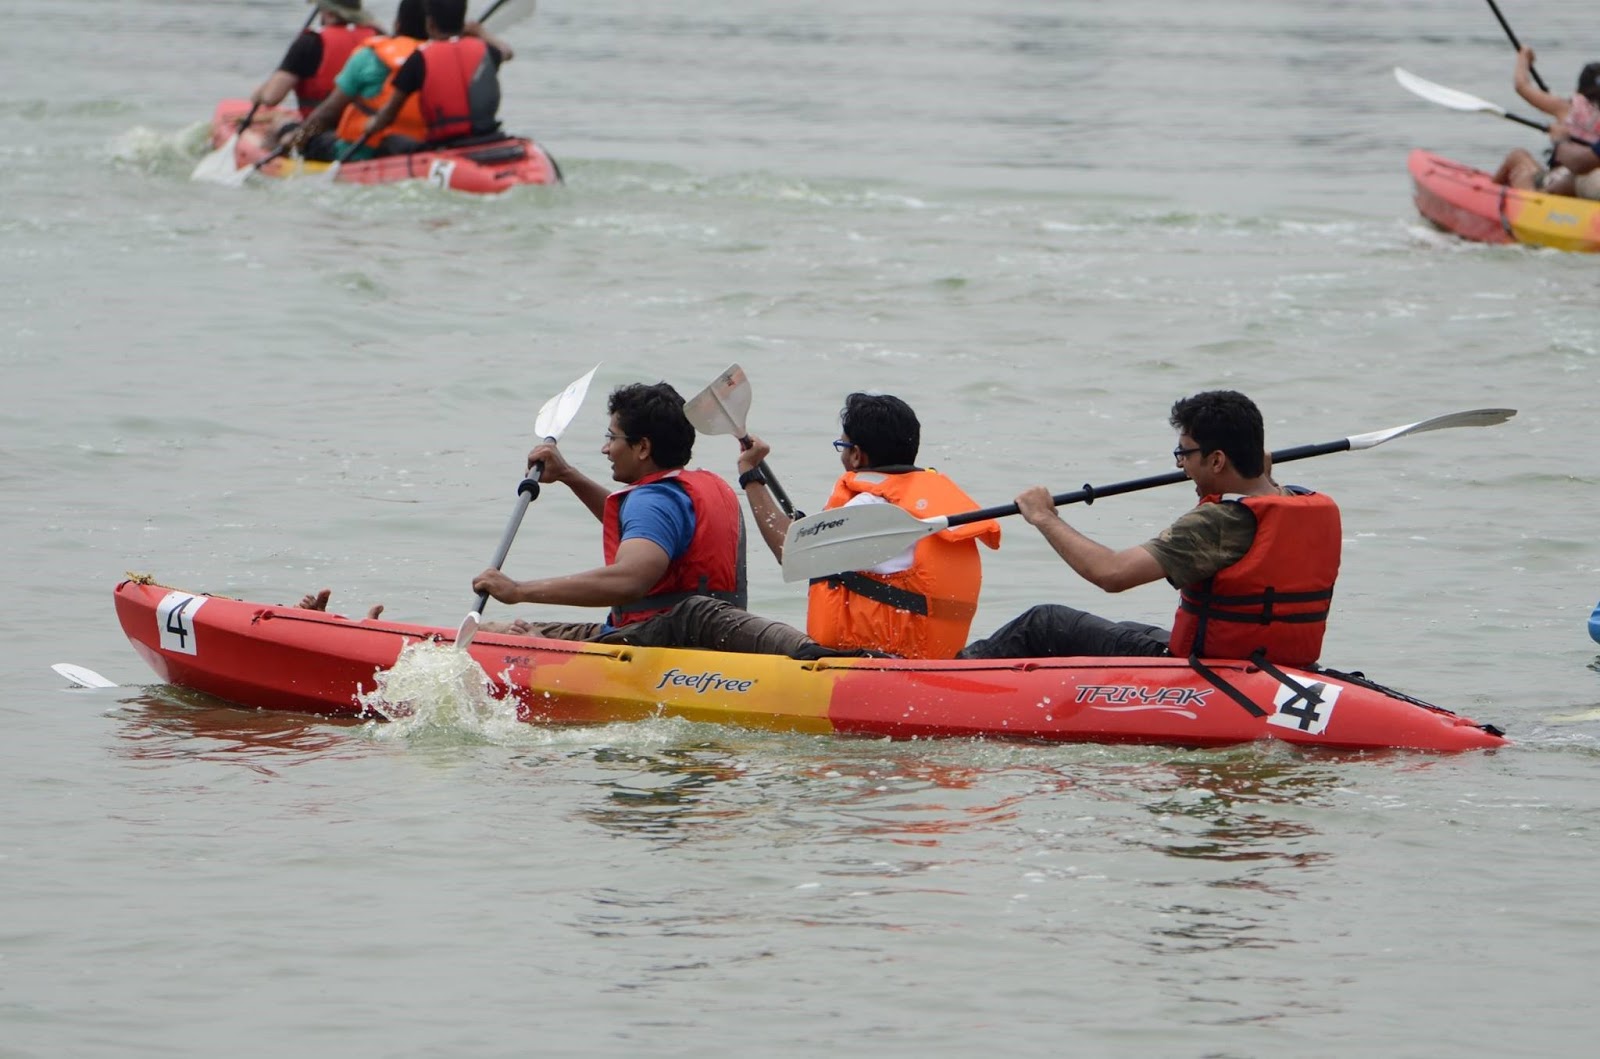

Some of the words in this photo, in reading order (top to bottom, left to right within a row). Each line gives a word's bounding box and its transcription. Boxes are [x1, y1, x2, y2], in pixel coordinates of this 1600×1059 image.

[167, 597, 194, 648] 4
[655, 668, 753, 694] feelfree
[1279, 682, 1327, 731] 4
